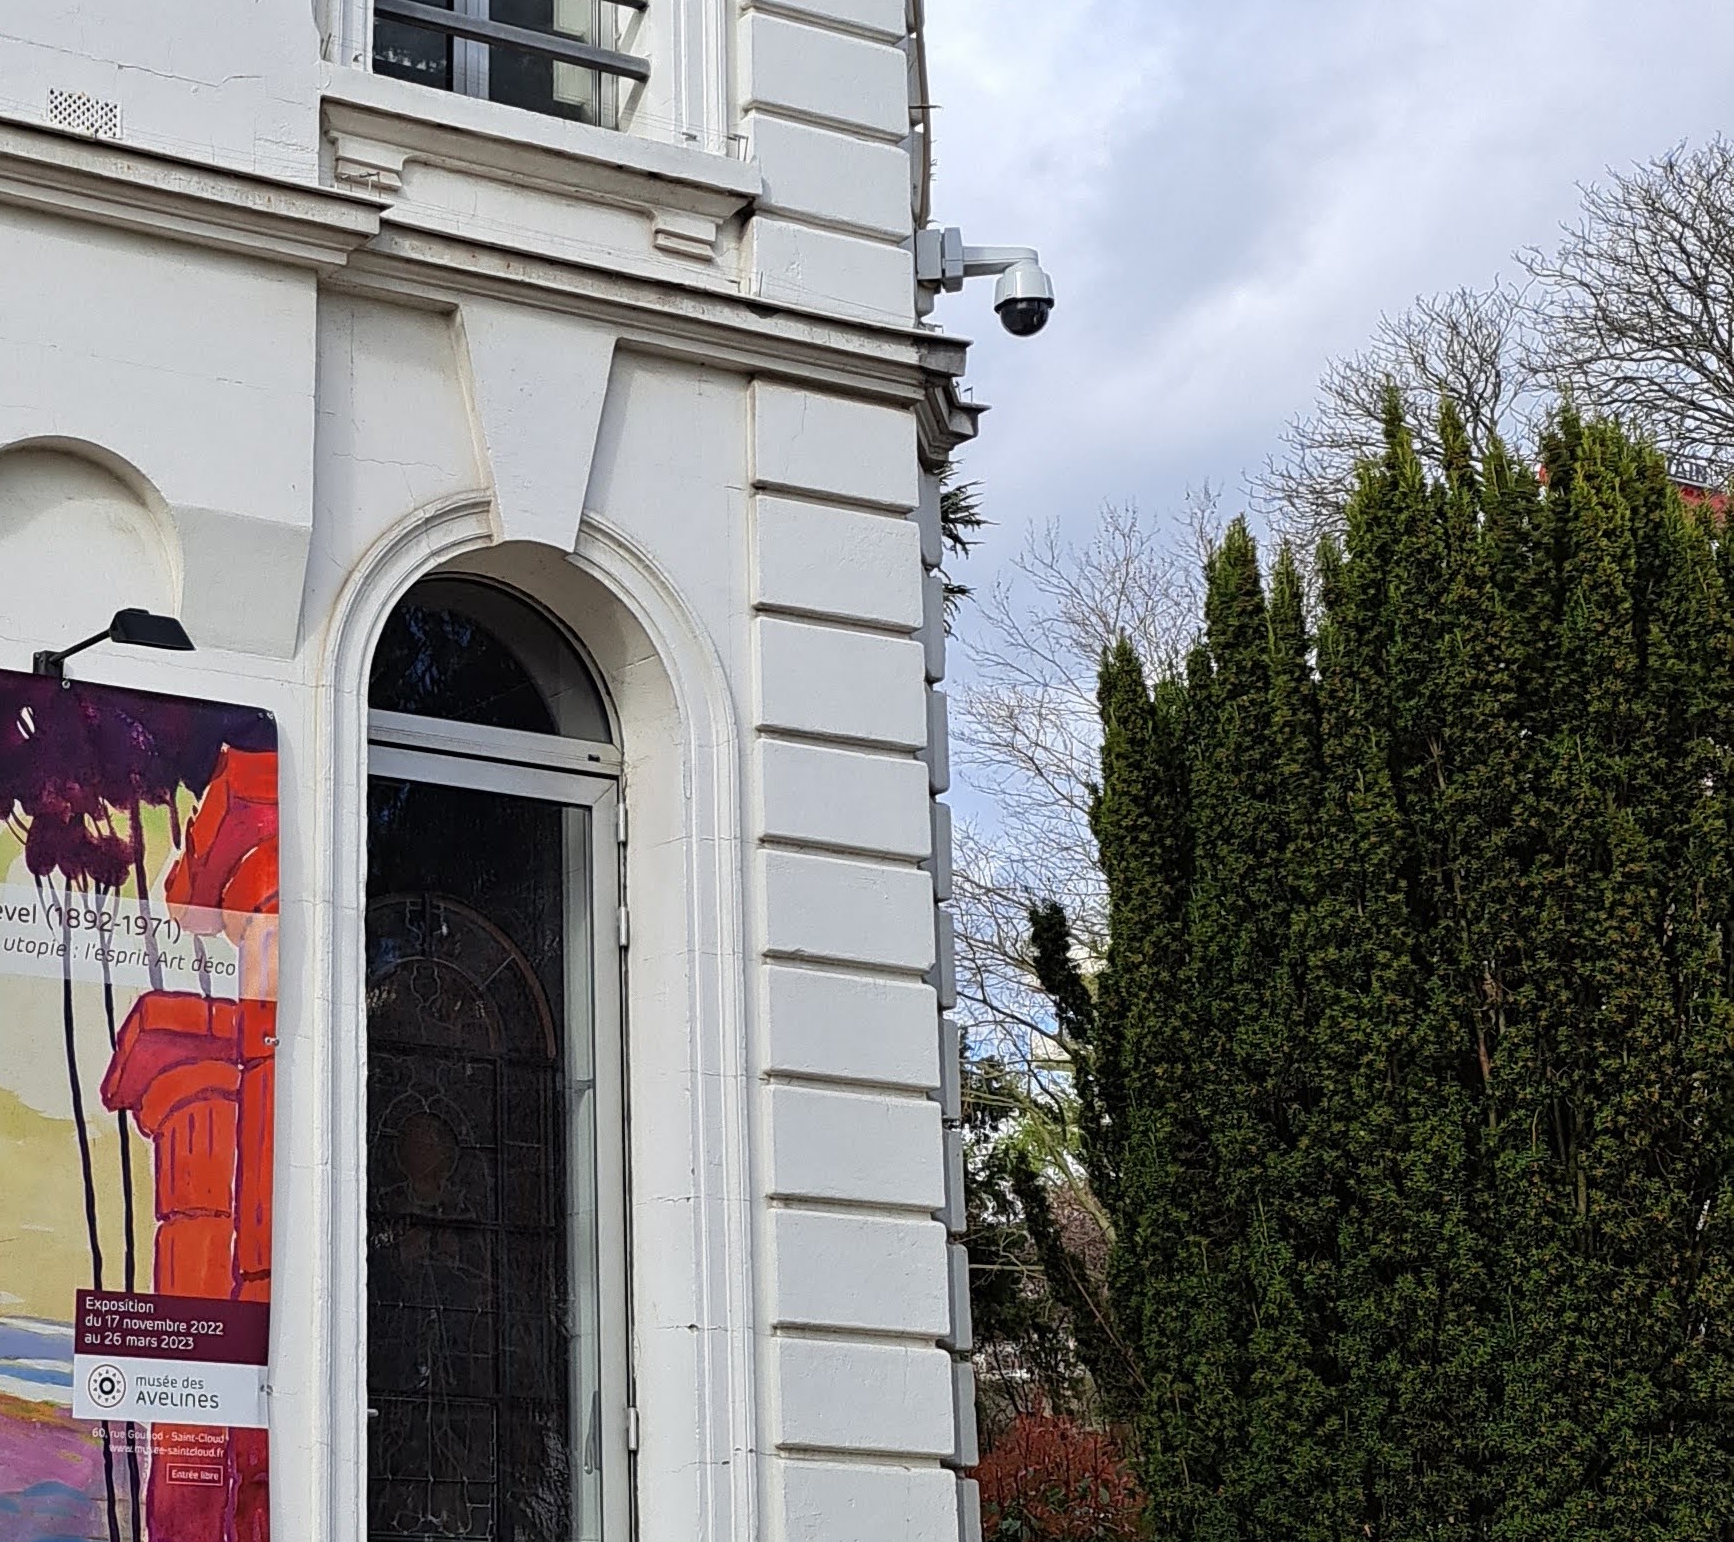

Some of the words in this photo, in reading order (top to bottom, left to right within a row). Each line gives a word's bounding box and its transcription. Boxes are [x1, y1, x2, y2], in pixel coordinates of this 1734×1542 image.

[46, 903, 181, 945] (1892-1971)
[3, 936, 67, 959] utopie
[84, 942, 150, 968] l'esprit
[154, 951, 184, 971] Art
[191, 957, 236, 976] déco
[85, 1296, 154, 1314] Exposition
[85, 1314, 102, 1328] du
[105, 1315, 120, 1328] 17
[122, 1318, 187, 1333] novembre
[190, 1320, 224, 1336] 2022
[84, 1333, 101, 1344] au
[104, 1332, 122, 1346] 26
[125, 1336, 158, 1348] mars
[160, 1335, 194, 1350] 2023
[135, 1375, 178, 1389] musée
[181, 1376, 204, 1390] des
[110, 1430, 126, 1439] rue
[127, 1428, 164, 1441] Gouod
[171, 1431, 225, 1443] Saint-Cloud
[109, 1444, 225, 1458] www.muee-saintcloud.fr
